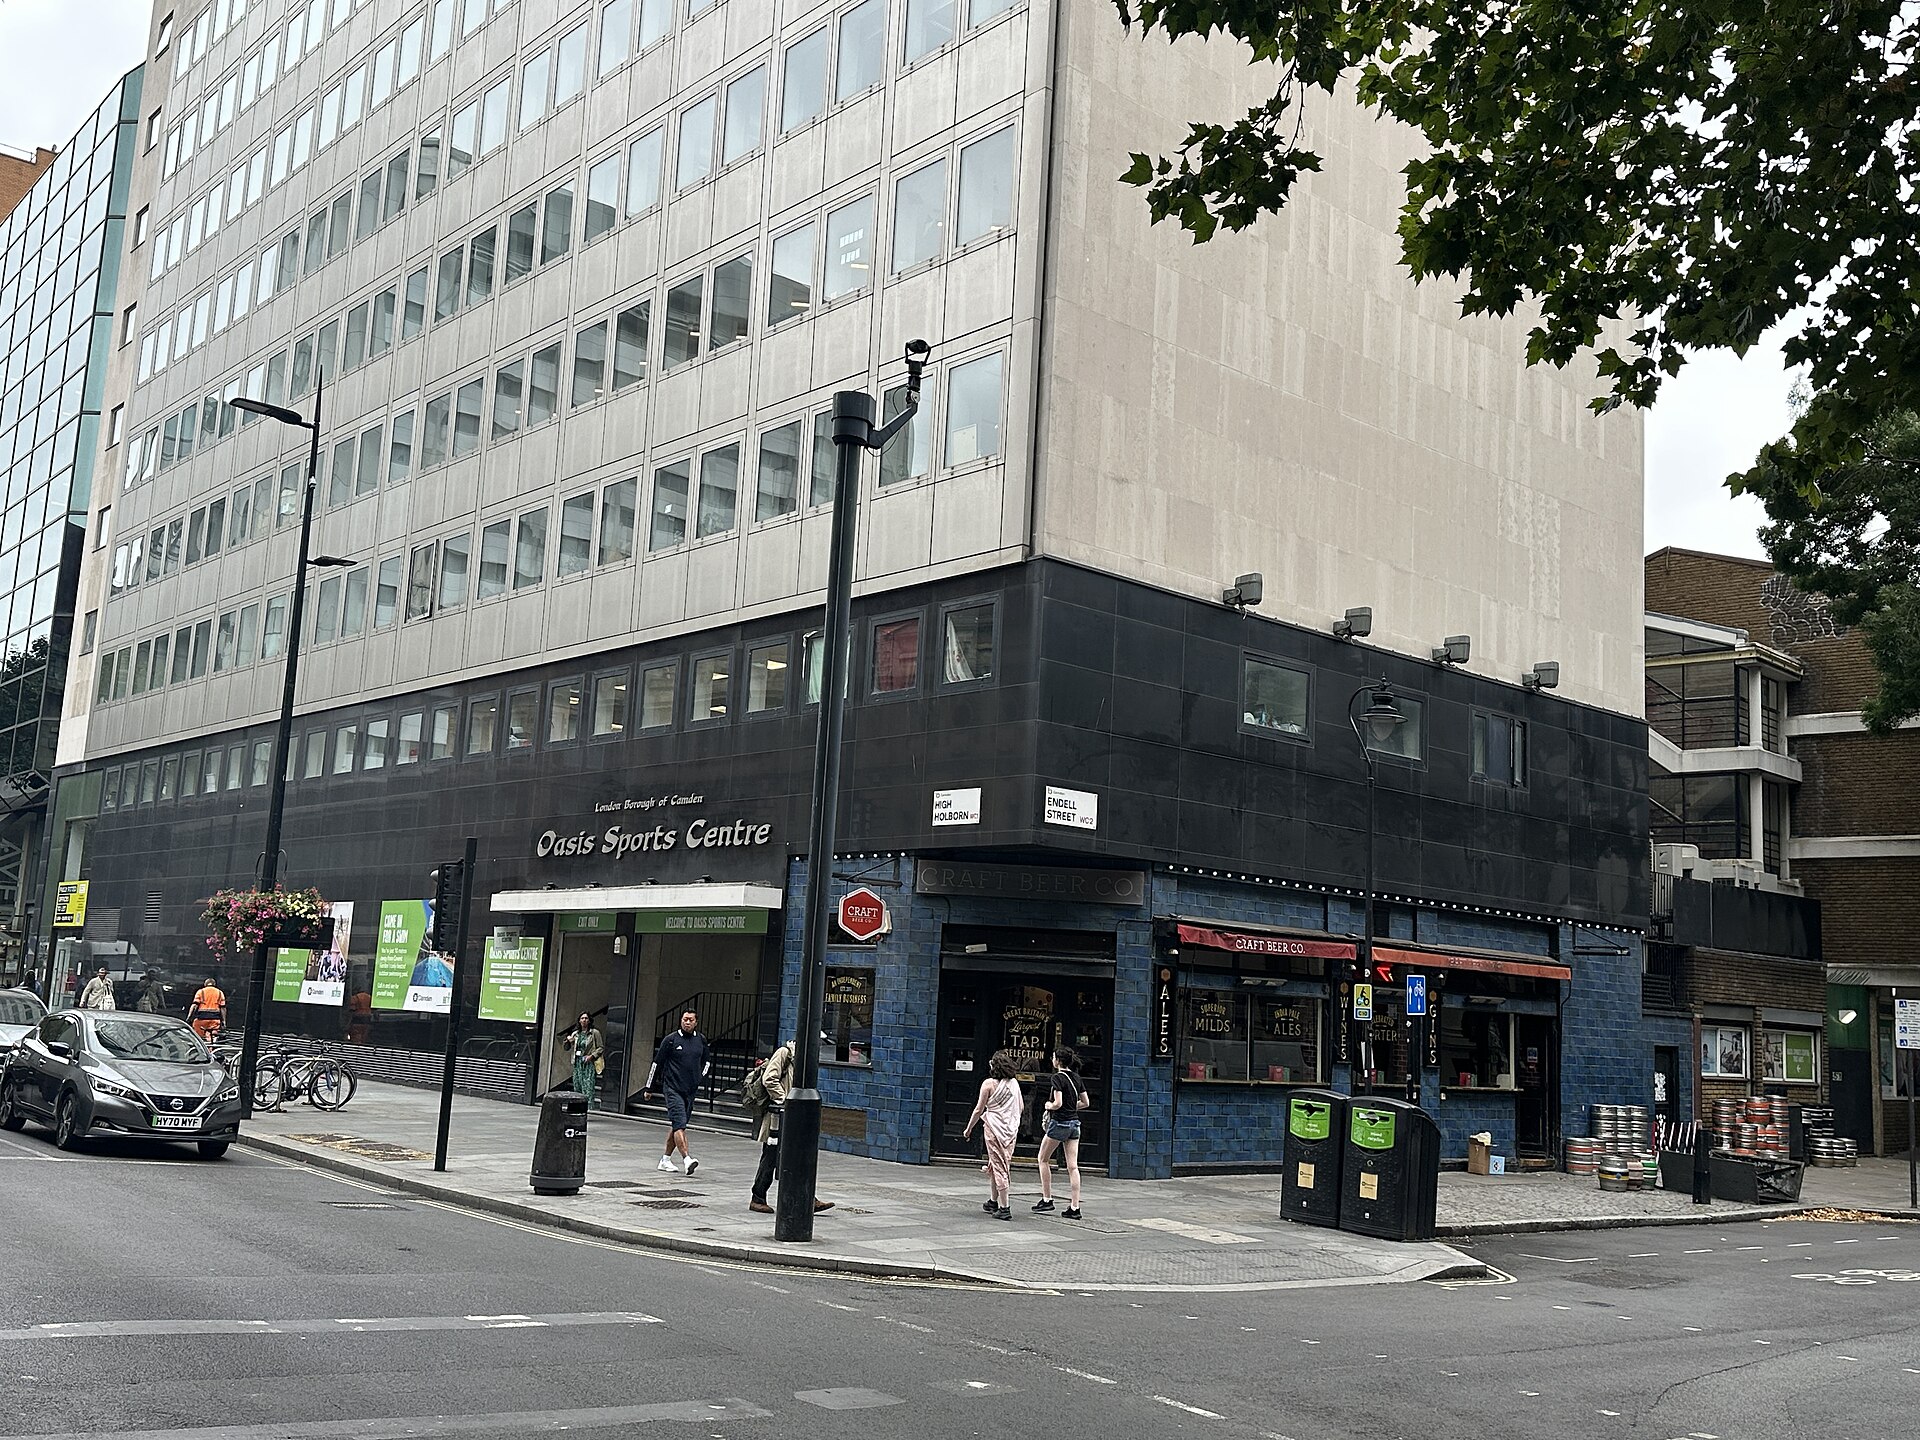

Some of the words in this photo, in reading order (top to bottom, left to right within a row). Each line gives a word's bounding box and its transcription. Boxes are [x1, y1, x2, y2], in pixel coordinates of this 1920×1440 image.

[594, 802, 622, 812] London
[624, 798, 654, 810] Borough
[658, 796, 667, 806] of
[670, 793, 704, 806] Camden
[934, 800, 952, 810] HIGH
[1048, 797, 1077, 811] ENDELL
[934, 811, 969, 822] HOLBORN
[1047, 810, 1076, 822] STREET
[1080, 816, 1094, 825] WC2
[537, 830, 596, 857] Oasis
[601, 825, 678, 860] Sports
[686, 818, 771, 849] Centre
[920, 866, 1008, 890] CRAFT
[1020, 872, 1086, 894] BEER
[848, 906, 878, 918] CRAFT
[384, 915, 397, 928] COME
[397, 914, 403, 928] IN
[578, 916, 587, 927] EXIT
[588, 916, 599, 927] ONLY
[665, 916, 686, 928] WELCOME
[687, 916, 693, 928] TO
[694, 916, 708, 928] OASIS
[708, 916, 726, 928] SPORTS
[727, 916, 746, 928] CENTRE
[383, 930, 392, 943] FOR
[396, 930, 409, 943] SWIM
[1235, 938, 1264, 951] CRAFT
[1266, 941, 1288, 953] BEER
[1290, 943, 1306, 954] CO.
[521, 947, 538, 960] CENTRE
[843, 994, 867, 1005] BUSINESS
[1002, 1008, 1021, 1020] GREAT
[1200, 1002, 1226, 1016] SUPERIOR
[1274, 1008, 1288, 1020] INDIA
[1288, 1008, 1300, 1020] PALE
[1160, 984, 1170, 1053] ALES
[1009, 1021, 1041, 1034] Largest
[1195, 1018, 1230, 1033] MILDS
[1274, 1023, 1301, 1036] ALES
[1340, 996, 1349, 1060] WINES
[1011, 1035, 1039, 1048] TAP
[1004, 1049, 1044, 1059] SELECTION
[156, 1117, 180, 1126] HY70
[181, 1117, 199, 1126] MYF
